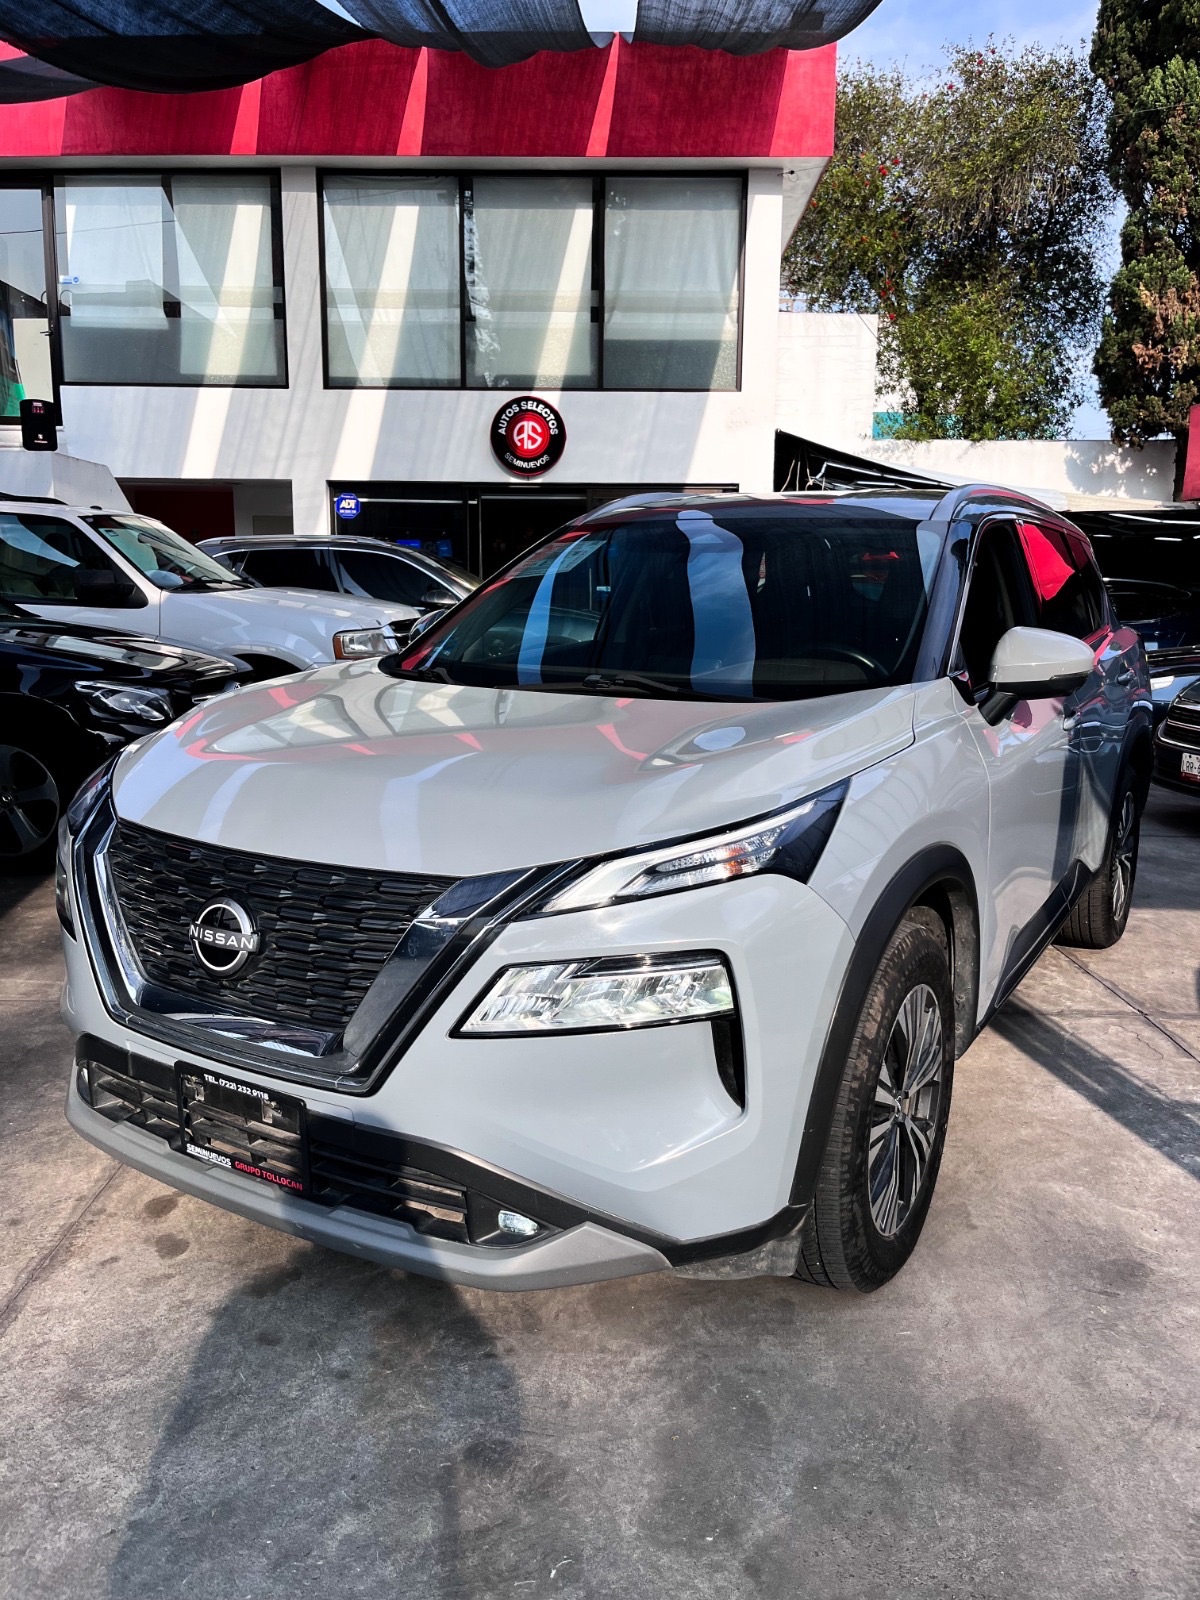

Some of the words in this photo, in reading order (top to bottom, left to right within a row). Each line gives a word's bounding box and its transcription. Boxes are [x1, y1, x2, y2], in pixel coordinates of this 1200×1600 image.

[498, 404, 519, 435] AUTOS
[521, 401, 558, 435] SELECTOS
[513, 421, 543, 449] AS
[504, 452, 550, 468] SEMINUEVOS
[340, 499, 357, 509] ADT
[190, 924, 253, 949] NISSAN
[219, 1079, 237, 1090] (722)
[237, 1084, 252, 1095] 232
[186, 1143, 231, 1166] SEMINUEVOS
[235, 1161, 260, 1176] GRUPO
[261, 1170, 303, 1191] TOLLOCAN
